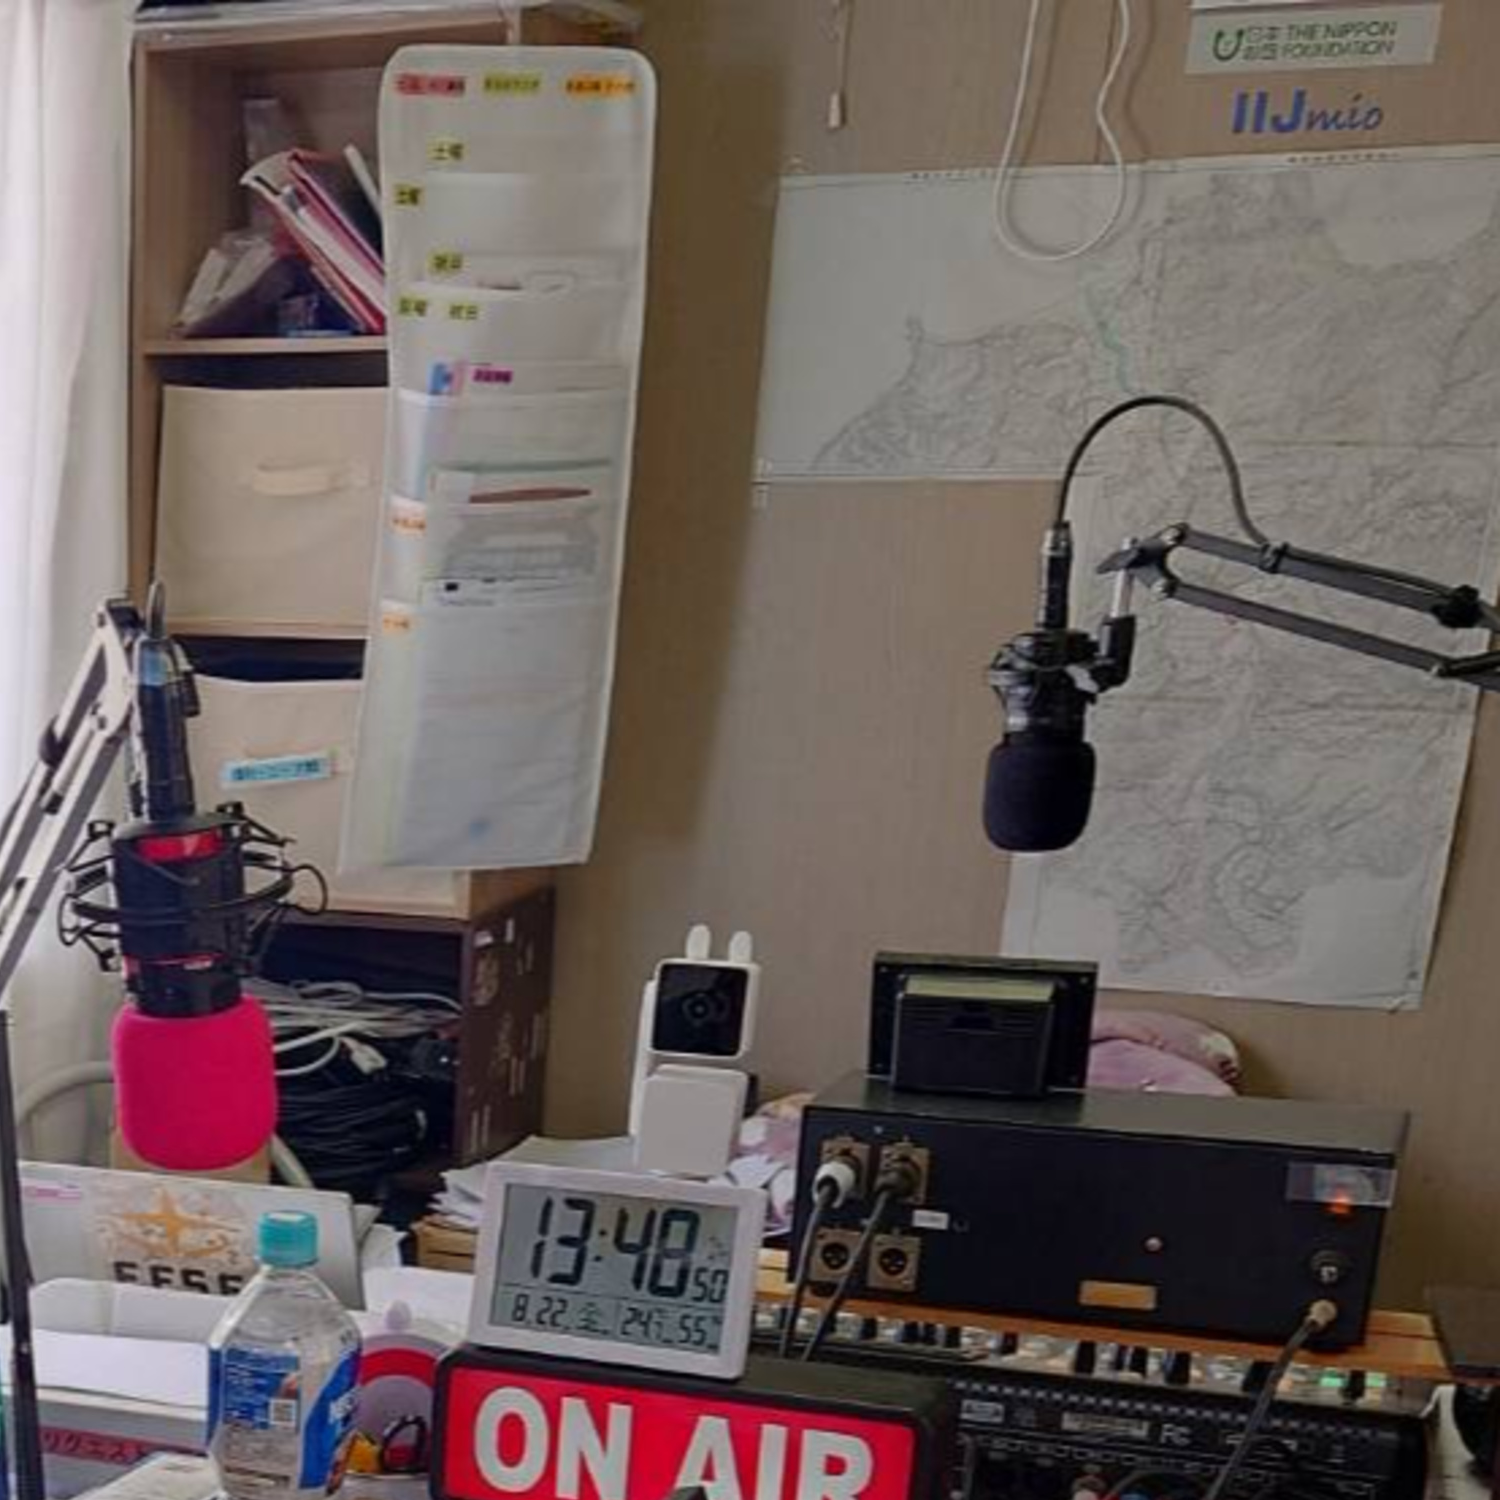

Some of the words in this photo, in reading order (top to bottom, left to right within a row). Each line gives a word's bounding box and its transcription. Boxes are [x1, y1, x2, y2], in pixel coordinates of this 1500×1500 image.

[1287, 23, 1321, 40] THE
[1324, 20, 1397, 38] NIPPON
[1281, 40, 1395, 59] FOUNDATION
[530, 1195, 700, 1298] 13:48
